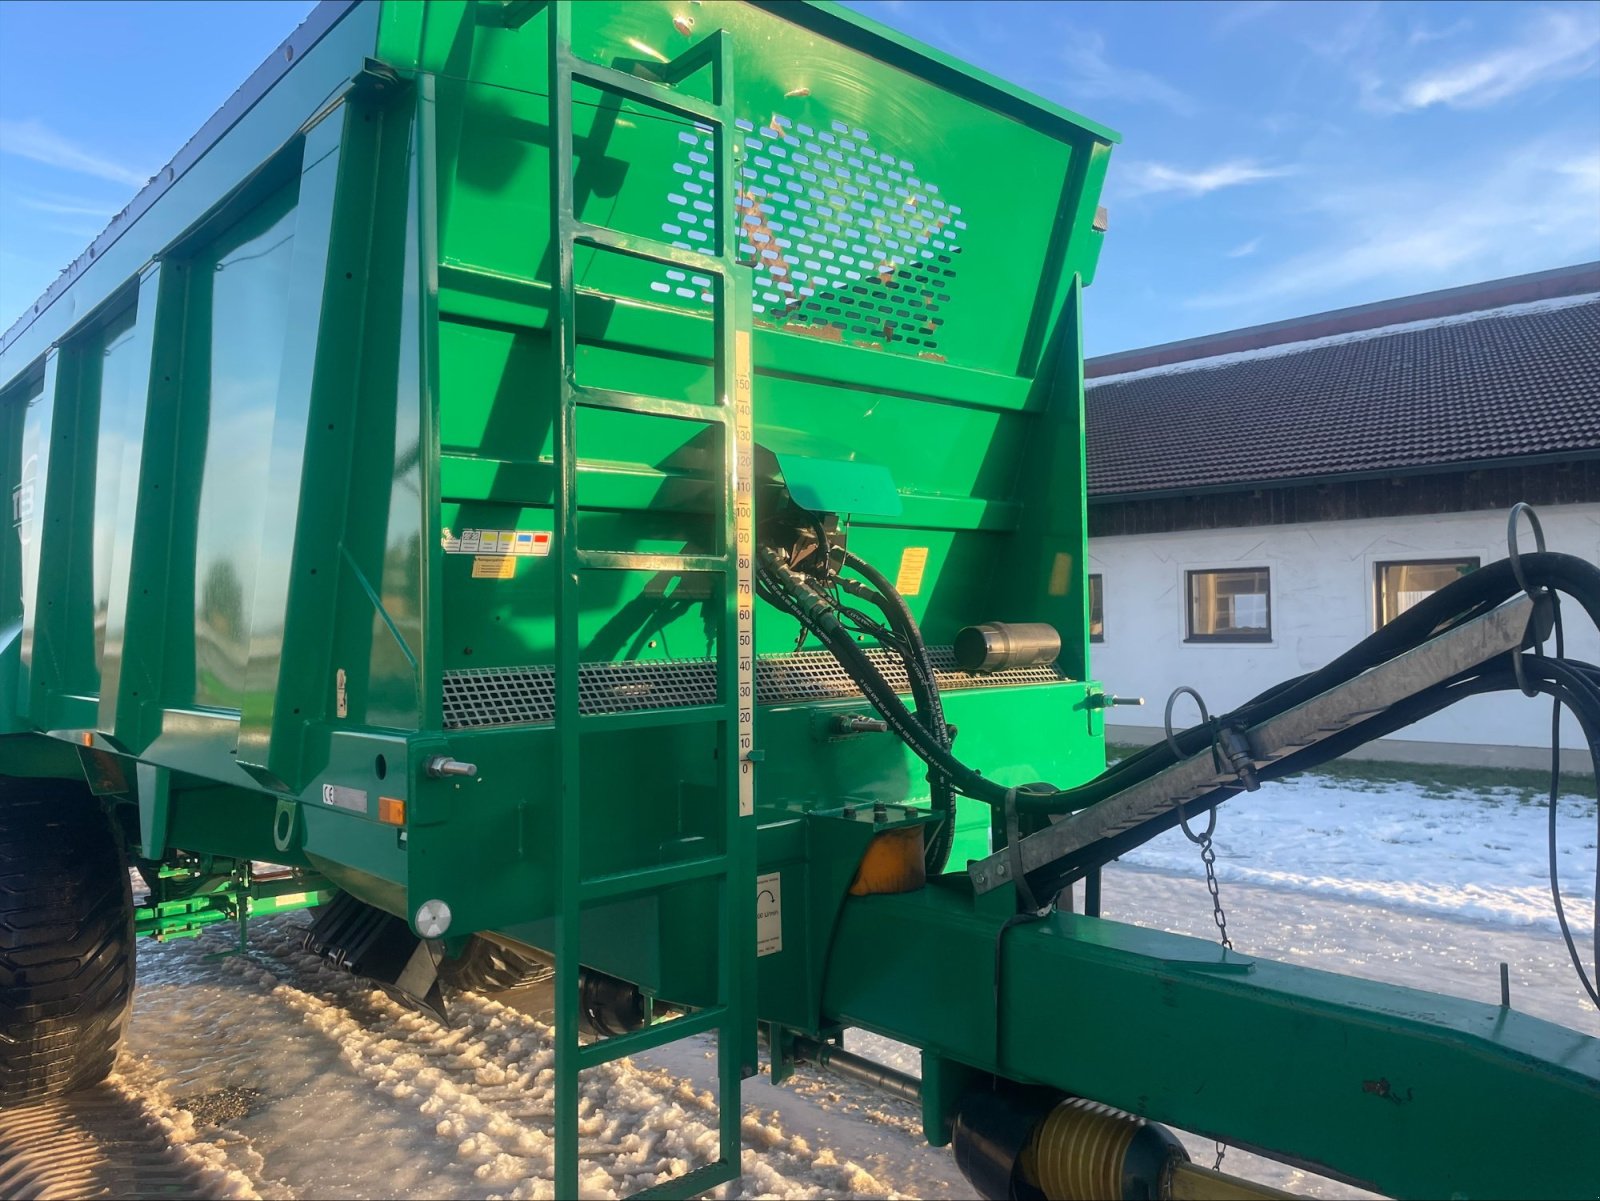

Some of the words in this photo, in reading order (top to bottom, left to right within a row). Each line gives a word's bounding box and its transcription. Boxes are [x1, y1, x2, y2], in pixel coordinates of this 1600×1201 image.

[736, 379, 750, 390] 150
[736, 404, 750, 416] 140
[736, 430, 750, 441] 130
[736, 456, 751, 467] 120
[736, 482, 751, 492] 110
[736, 507, 751, 518] 100
[738, 532, 750, 544] 90
[738, 558, 750, 569] 80
[738, 584, 750, 594] 70
[739, 609, 750, 620] 60
[739, 635, 750, 646] 50
[739, 660, 750, 671] 40
[740, 686, 750, 697] 30
[740, 712, 750, 722] 20
[740, 738, 750, 748] 10
[742, 764, 748, 774] 0
